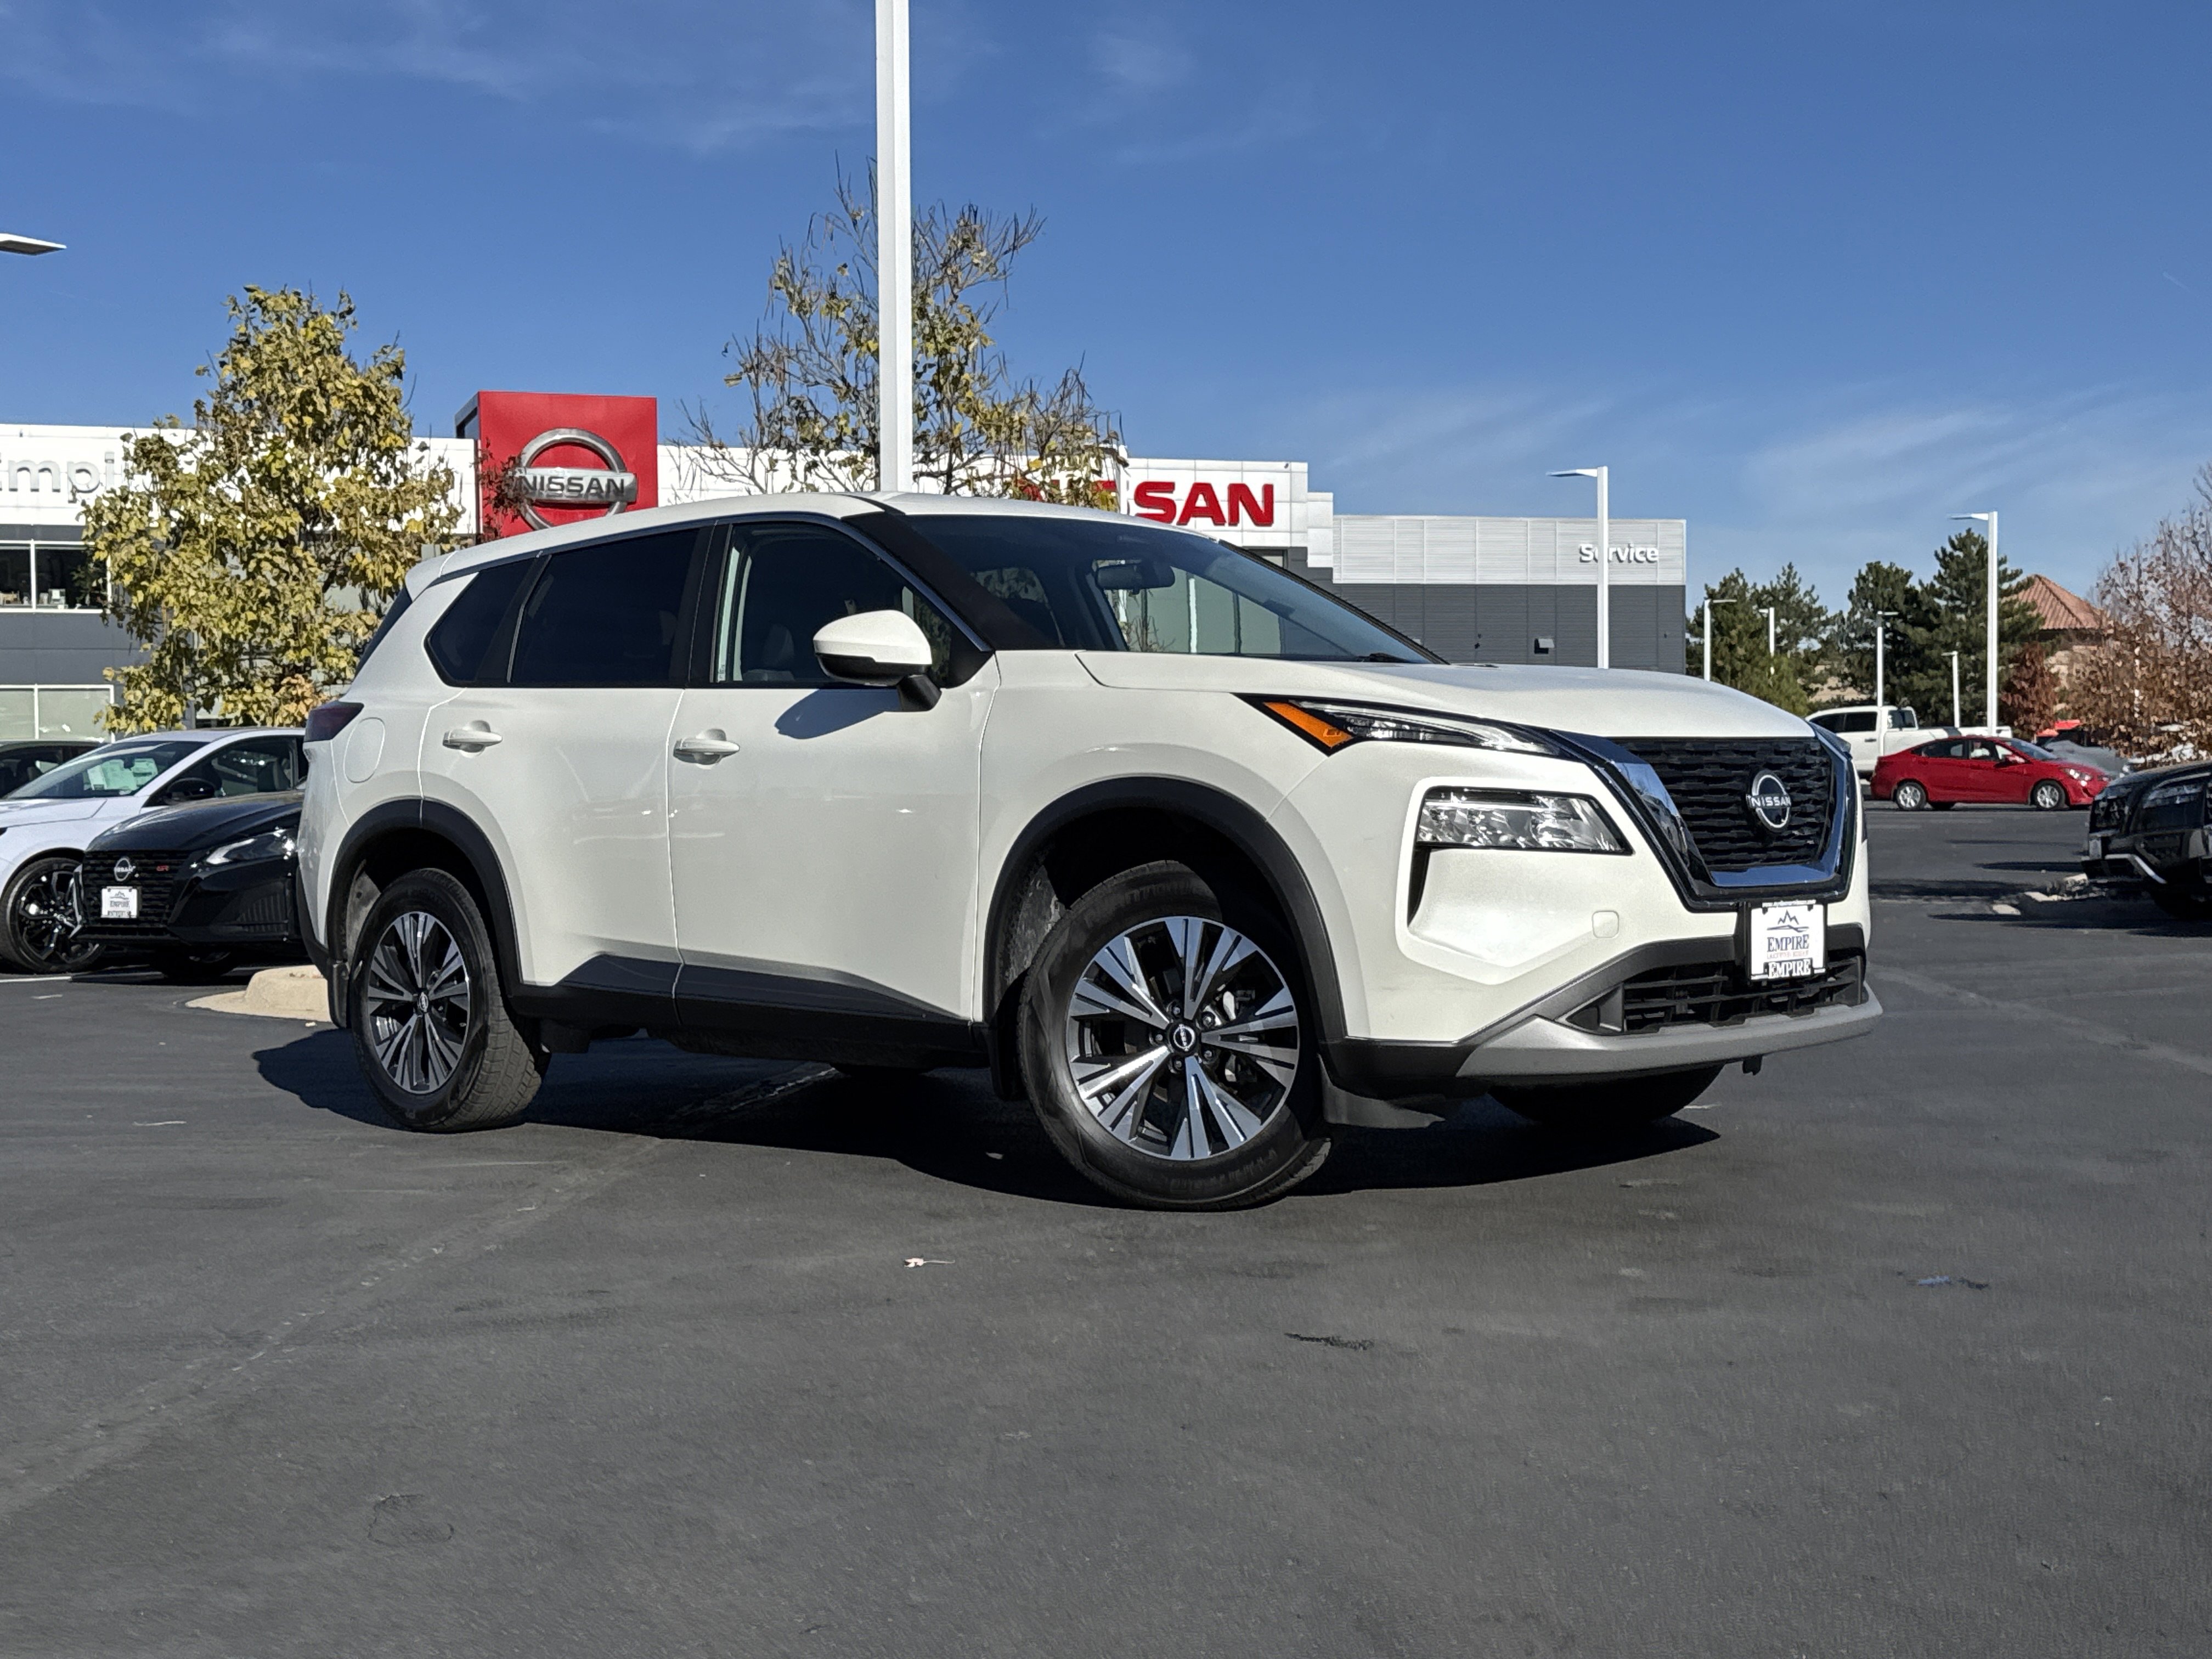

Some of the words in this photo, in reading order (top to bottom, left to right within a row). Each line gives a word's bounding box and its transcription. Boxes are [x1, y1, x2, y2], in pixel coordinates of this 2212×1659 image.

[517, 475, 624, 497] NISSAN
[1751, 796, 1792, 807] NISSAN
[1767, 934, 1809, 952] EMPIRE
[1768, 958, 1811, 979] EMPIRE
